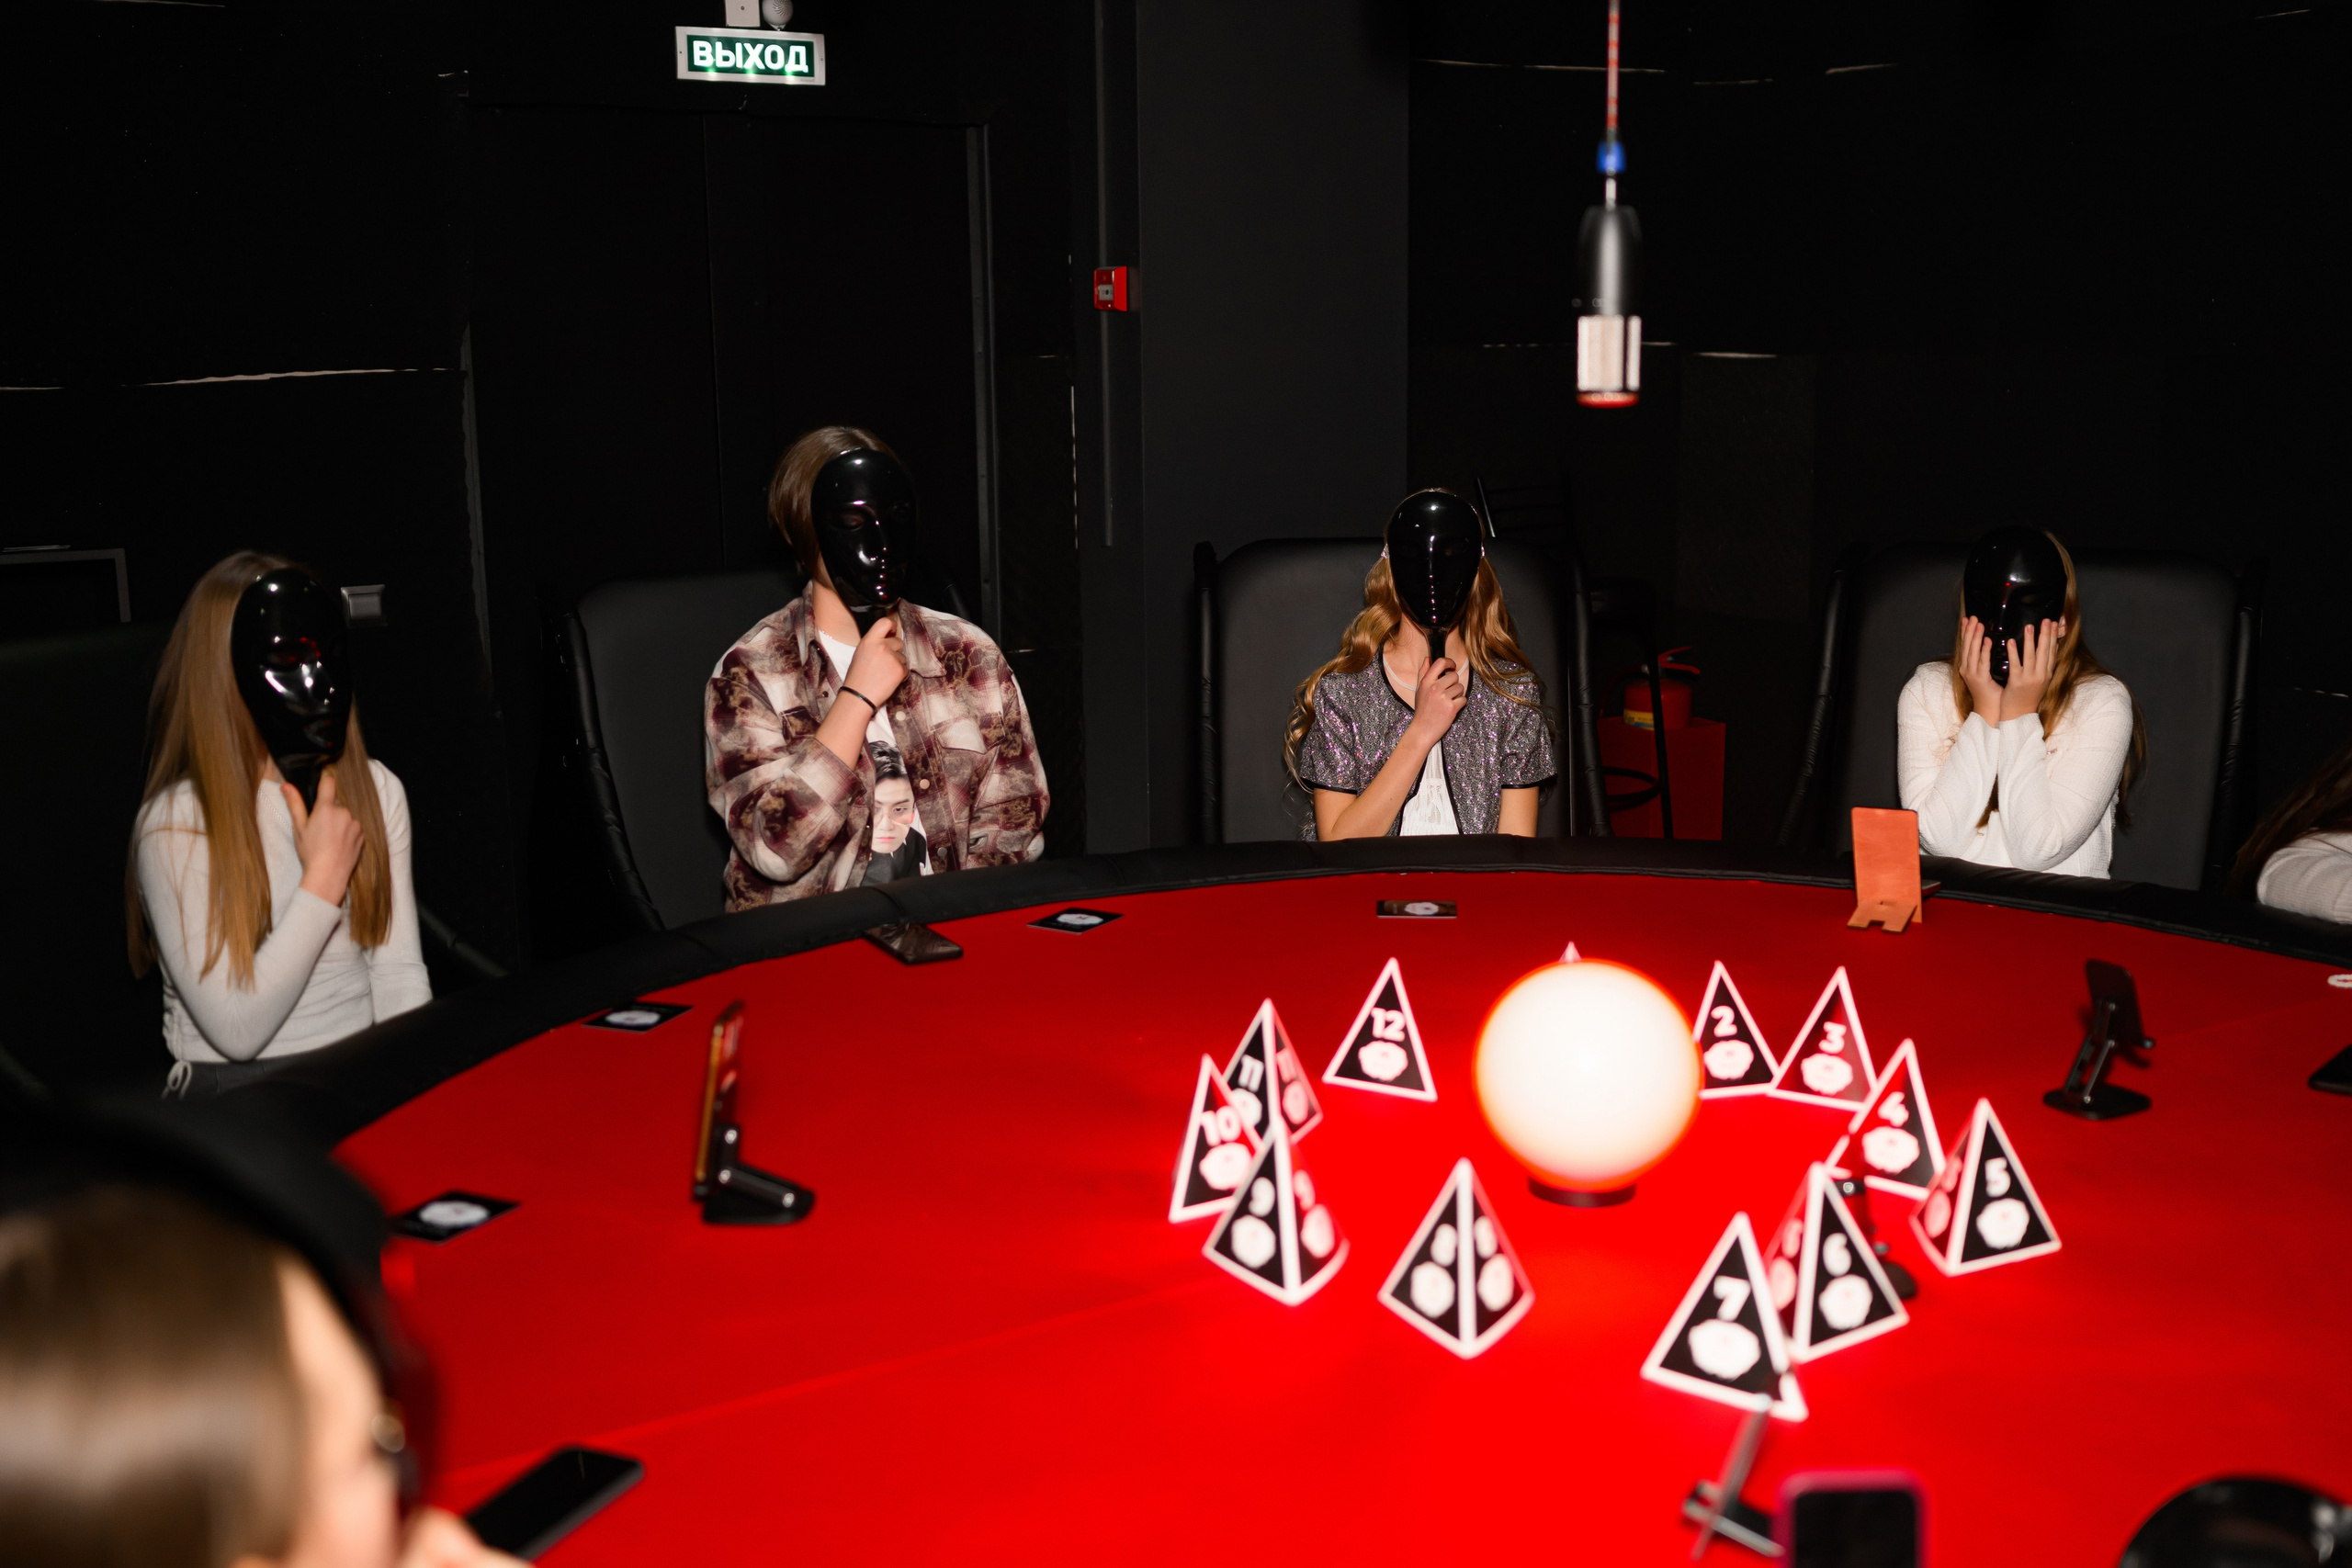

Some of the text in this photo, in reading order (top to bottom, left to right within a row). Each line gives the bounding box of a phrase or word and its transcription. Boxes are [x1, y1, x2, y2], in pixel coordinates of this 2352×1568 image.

[693, 40, 808, 73] ВЫХОД
[1370, 1007, 1407, 1042] 12
[1711, 1005, 1738, 1037] 2
[1818, 1021, 1848, 1055] 3
[1238, 1053, 1265, 1092] 11
[1199, 1105, 1242, 1147] 10
[1877, 1091, 1910, 1127] 4
[1984, 1156, 2011, 1198] 5
[1250, 1177, 1276, 1218] 9
[1822, 1233, 1852, 1276] 6
[1713, 1275, 1751, 1323] 7
